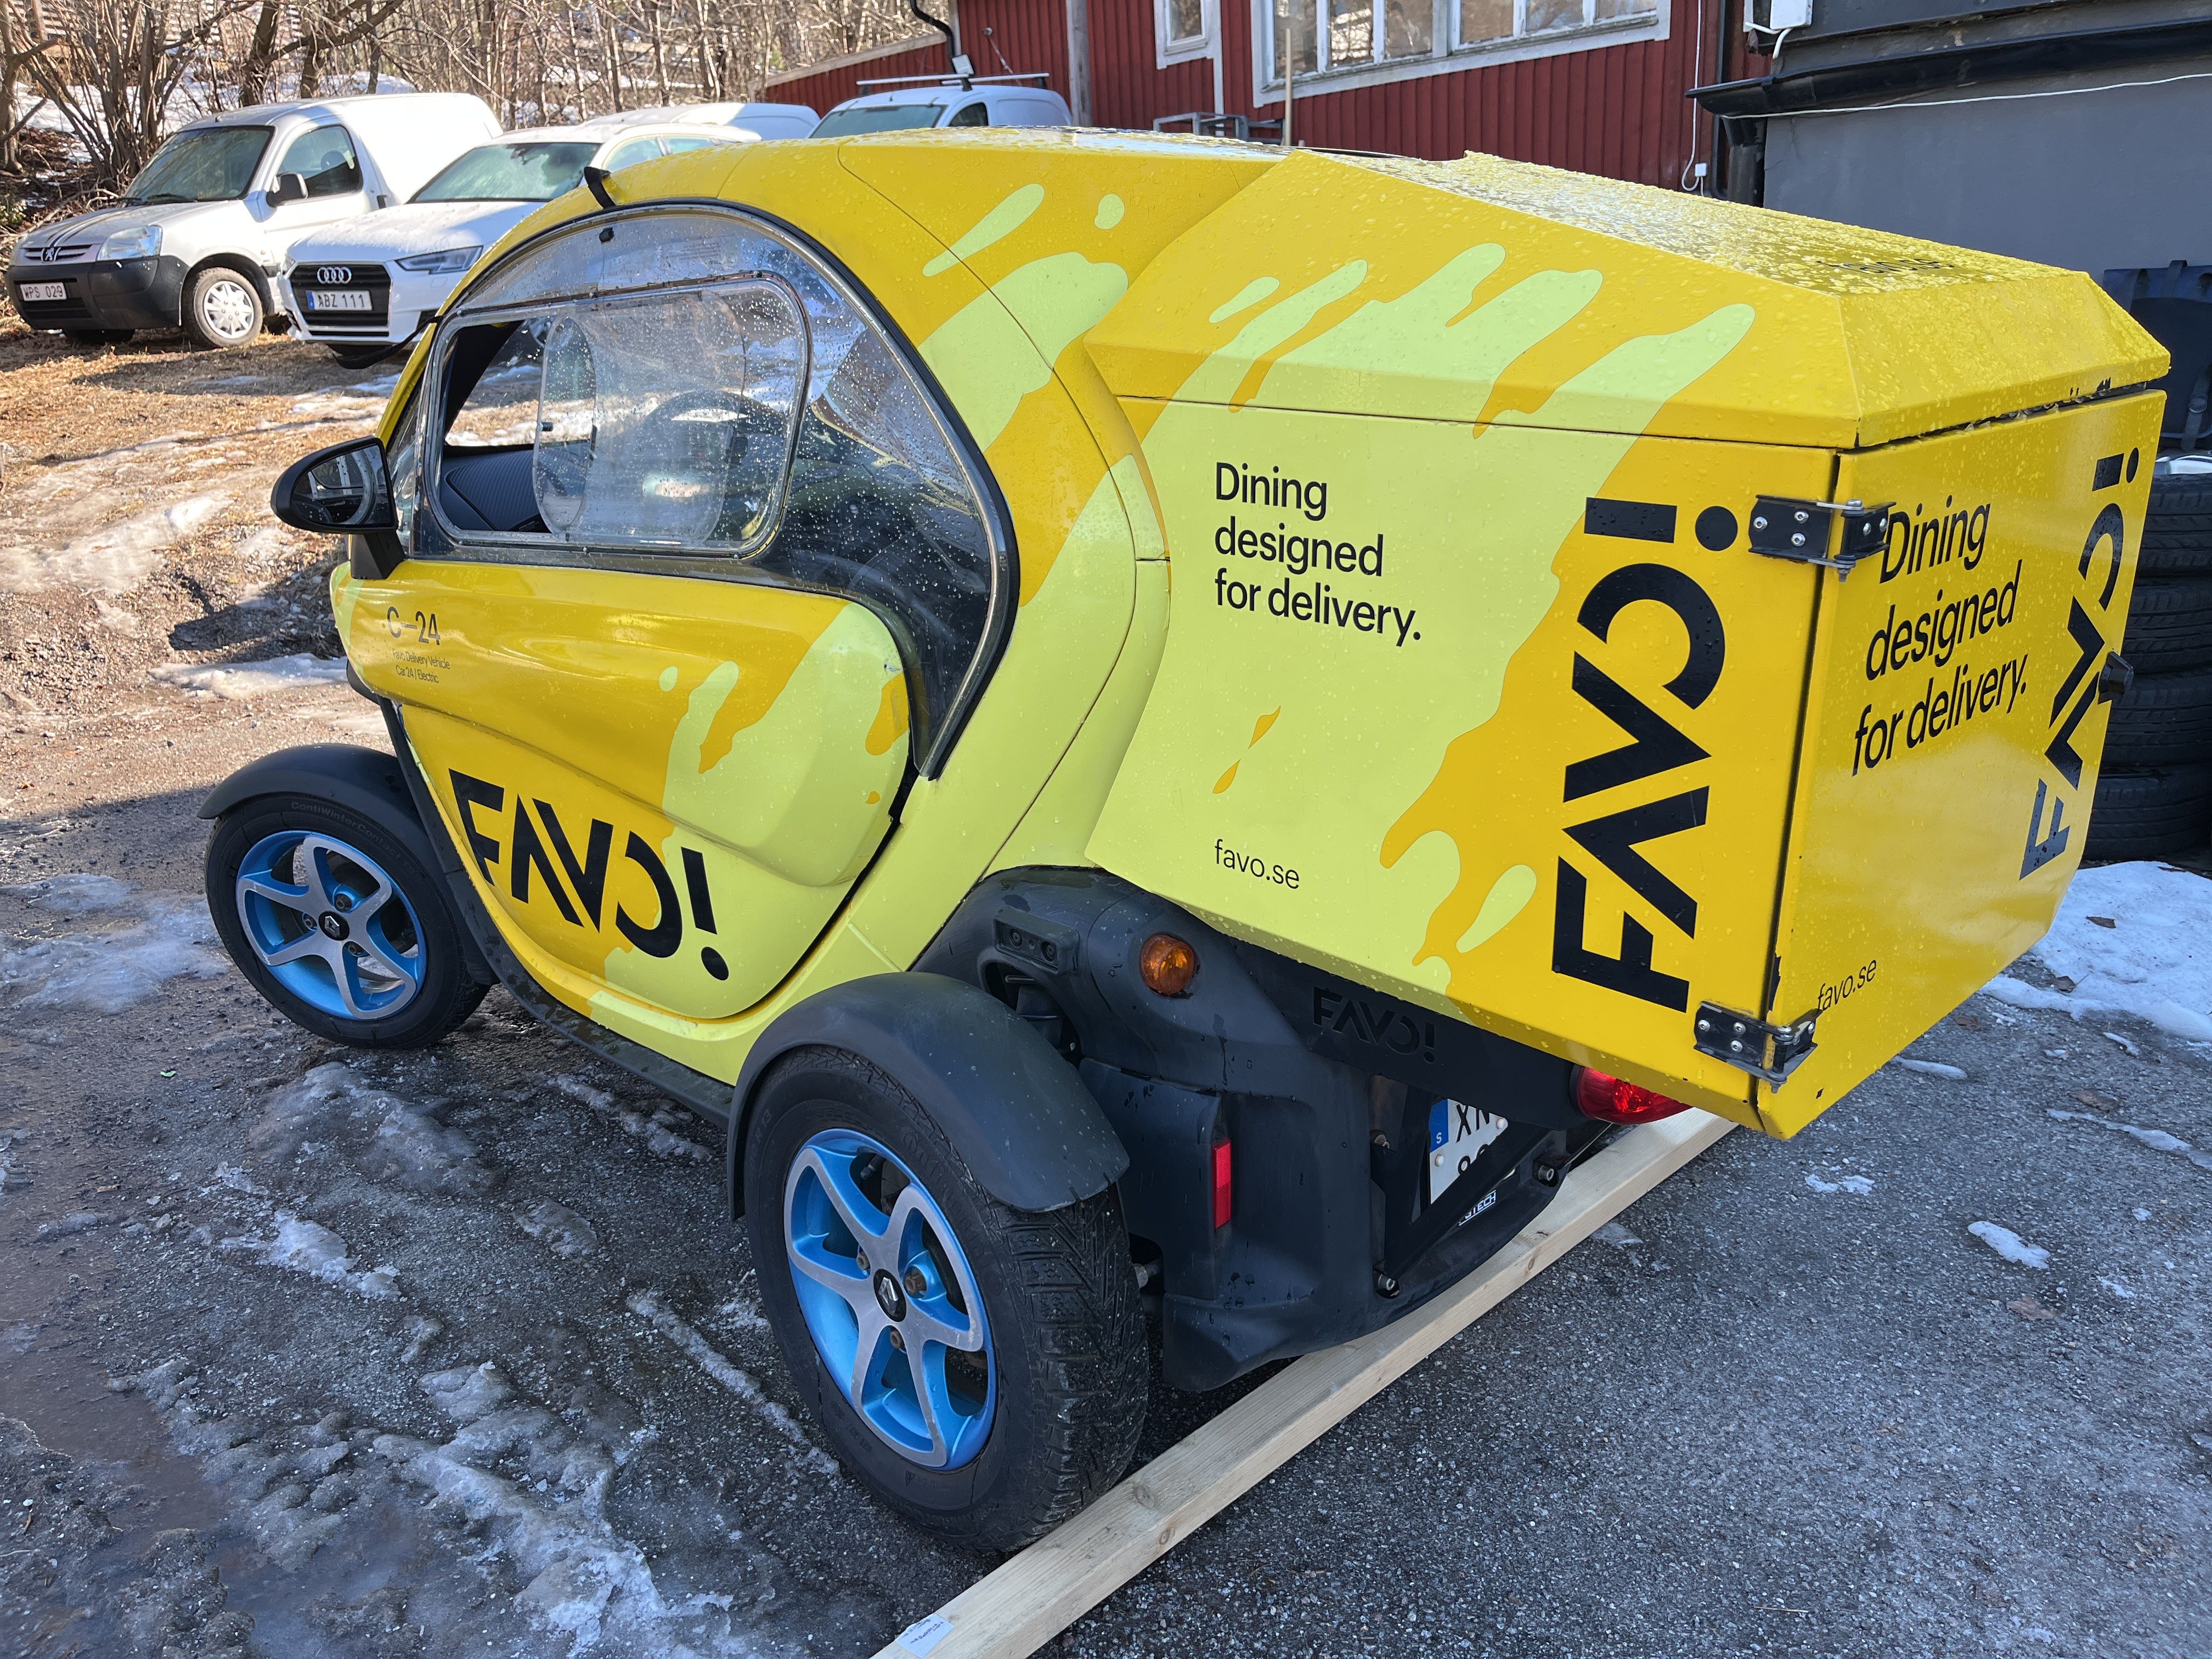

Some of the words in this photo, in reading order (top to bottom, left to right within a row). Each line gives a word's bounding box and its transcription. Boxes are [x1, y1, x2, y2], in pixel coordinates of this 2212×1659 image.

[22, 286, 41, 298] WPS
[45, 285, 63, 298] 029
[318, 294, 338, 308] ABZ
[342, 294, 365, 308] 111
[1216, 461, 1327, 521] Dining
[1215, 516, 1383, 577] designed
[1879, 495, 1991, 584] Dining
[1215, 567, 1261, 611] for
[1268, 577, 1421, 647] delivery.
[1865, 559, 2023, 682] designed
[396, 664, 405, 676] Car
[406, 667, 414, 678] 24
[417, 669, 439, 684] Electric
[405, 651, 427, 667] Delivery
[428, 656, 450, 669] Vehicle
[1852, 704, 1904, 777] for
[1906, 654, 2028, 750] delivery.
[1214, 838, 1300, 889] favo.se
[1818, 960, 1876, 1011] favo.se
[1436, 1132, 1442, 1144] S
